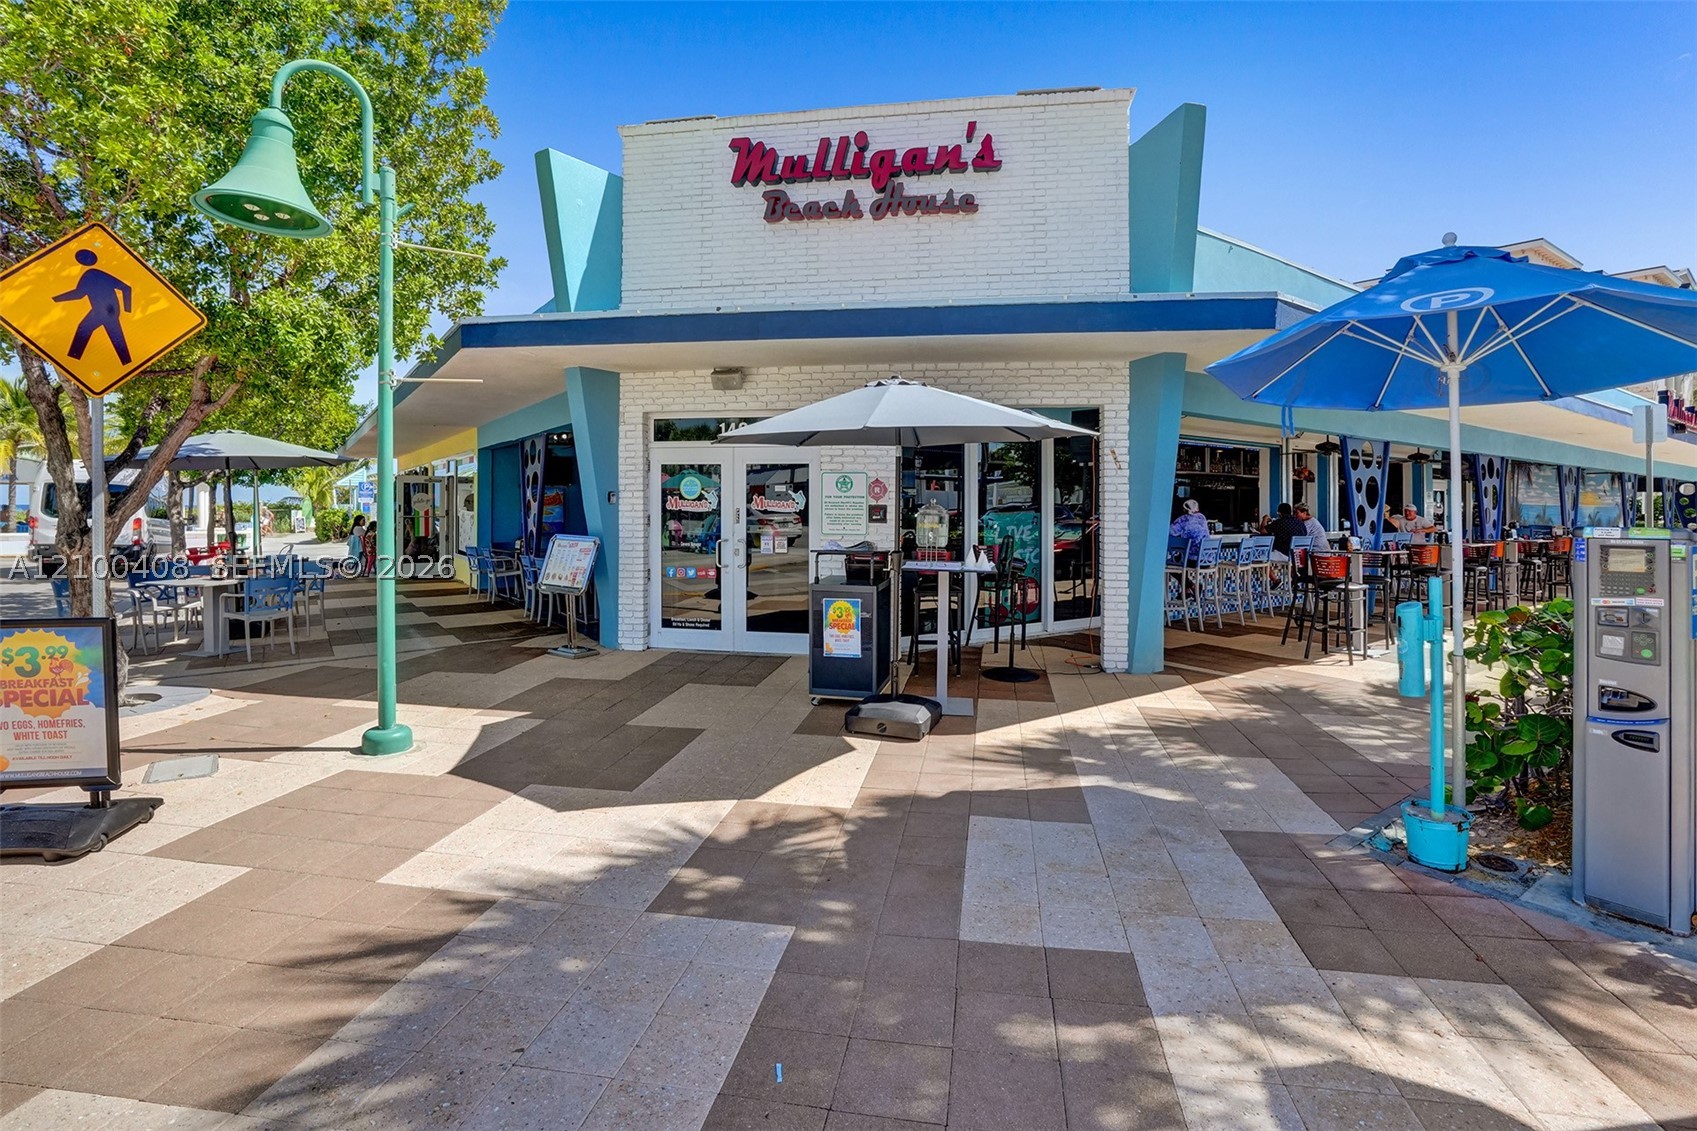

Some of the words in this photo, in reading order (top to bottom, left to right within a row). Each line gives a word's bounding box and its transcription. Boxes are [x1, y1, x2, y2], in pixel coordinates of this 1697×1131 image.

[728, 121, 1002, 194] Mulligan's
[761, 188, 864, 224] Beach
[869, 178, 979, 221] House
[1430, 293, 1471, 309] P
[874, 486, 881, 494] R
[829, 622, 855, 630] SPECIAL
[2, 645, 69, 678] $3.99
[0, 678, 74, 689] BREAKFAST
[0, 688, 89, 708] PECIAL
[12, 720, 36, 730] EGGS,
[38, 719, 85, 729] HOMEFRIES,
[14, 731, 40, 741] WHITE
[42, 730, 68, 739] TOAST
